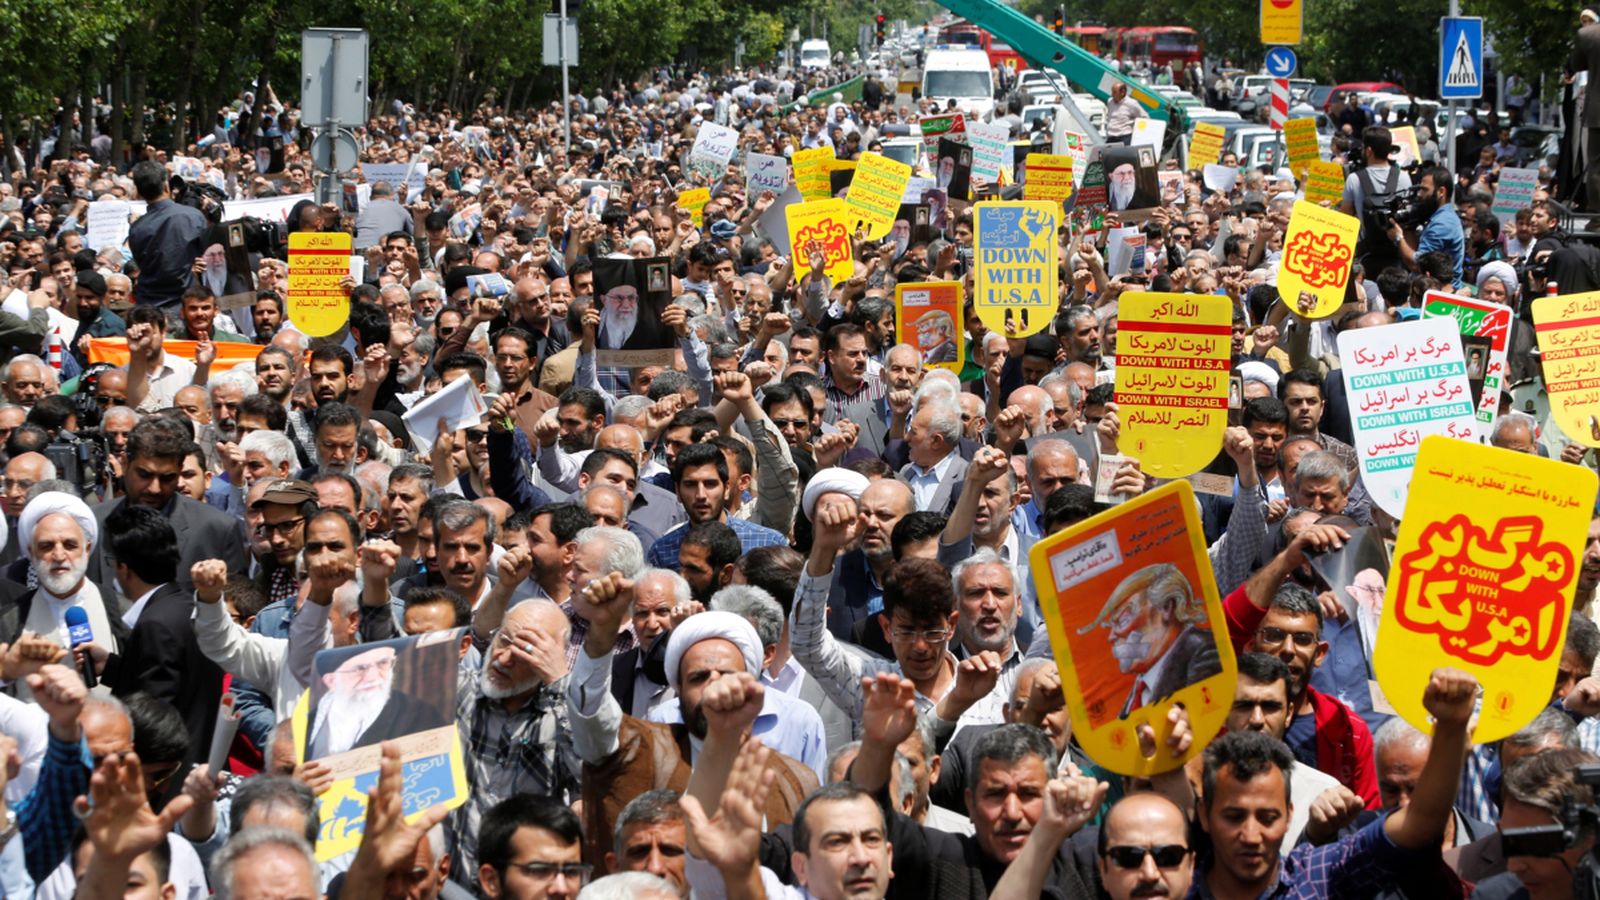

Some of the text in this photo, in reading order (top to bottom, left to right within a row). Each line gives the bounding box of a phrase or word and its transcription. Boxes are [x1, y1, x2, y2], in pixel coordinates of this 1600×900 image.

[984, 248, 1046, 264] DOWN
[1312, 234, 1348, 262] مرگ
[988, 268, 1042, 284] WITH
[1288, 250, 1345, 285] امریکا
[988, 288, 1042, 304] U.S.A
[1150, 300, 1199, 320] الله اكبر
[1129, 335, 1216, 355] الموت لامريكا
[1353, 336, 1451, 368] مرگ بر امریکا
[1545, 348, 1576, 360] DOWN
[1120, 356, 1224, 369] DOWN WITH U.S.A
[1125, 373, 1217, 393] الموت لاسرائيل
[1354, 363, 1461, 389] DOWN WITH U.S.A
[1432, 378, 1463, 400] مرگ
[1550, 380, 1578, 393] DOWN
[1118, 394, 1222, 407] DOWN WITH ISRAEL
[1359, 387, 1409, 413] اسرائیل
[1416, 389, 1428, 405] بر
[1128, 411, 1172, 430] للاسلام
[1359, 415, 1395, 430] DOWN
[1399, 409, 1427, 424] WITH
[1430, 405, 1471, 420] ISRAEL
[1368, 430, 1421, 456] انگلیس
[1367, 454, 1416, 470] DOWN WI
[1409, 523, 1566, 592] مرگ بر
[1458, 564, 1500, 584] DOWN
[1466, 582, 1499, 599] WITH
[1404, 570, 1556, 656] امریکا
[1476, 603, 1508, 619] U.S.A
